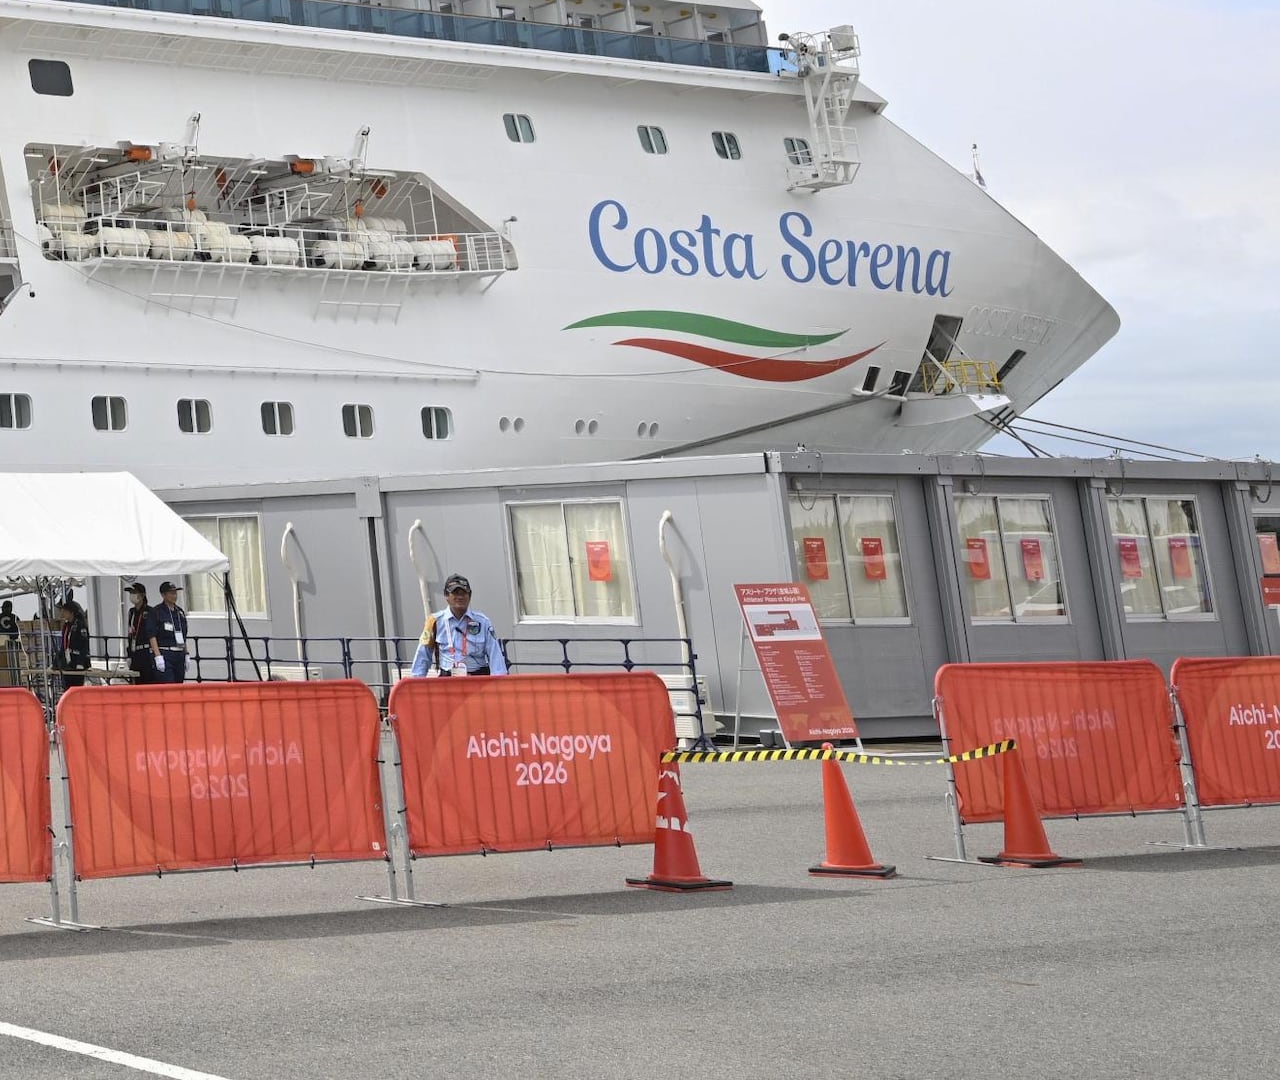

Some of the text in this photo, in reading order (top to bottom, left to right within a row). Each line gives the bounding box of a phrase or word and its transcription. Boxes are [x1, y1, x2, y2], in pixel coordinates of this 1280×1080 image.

[588, 199, 955, 299] Costa Serena
[466, 728, 612, 762] Aichi-Nagoya
[515, 762, 568, 787] 2026
